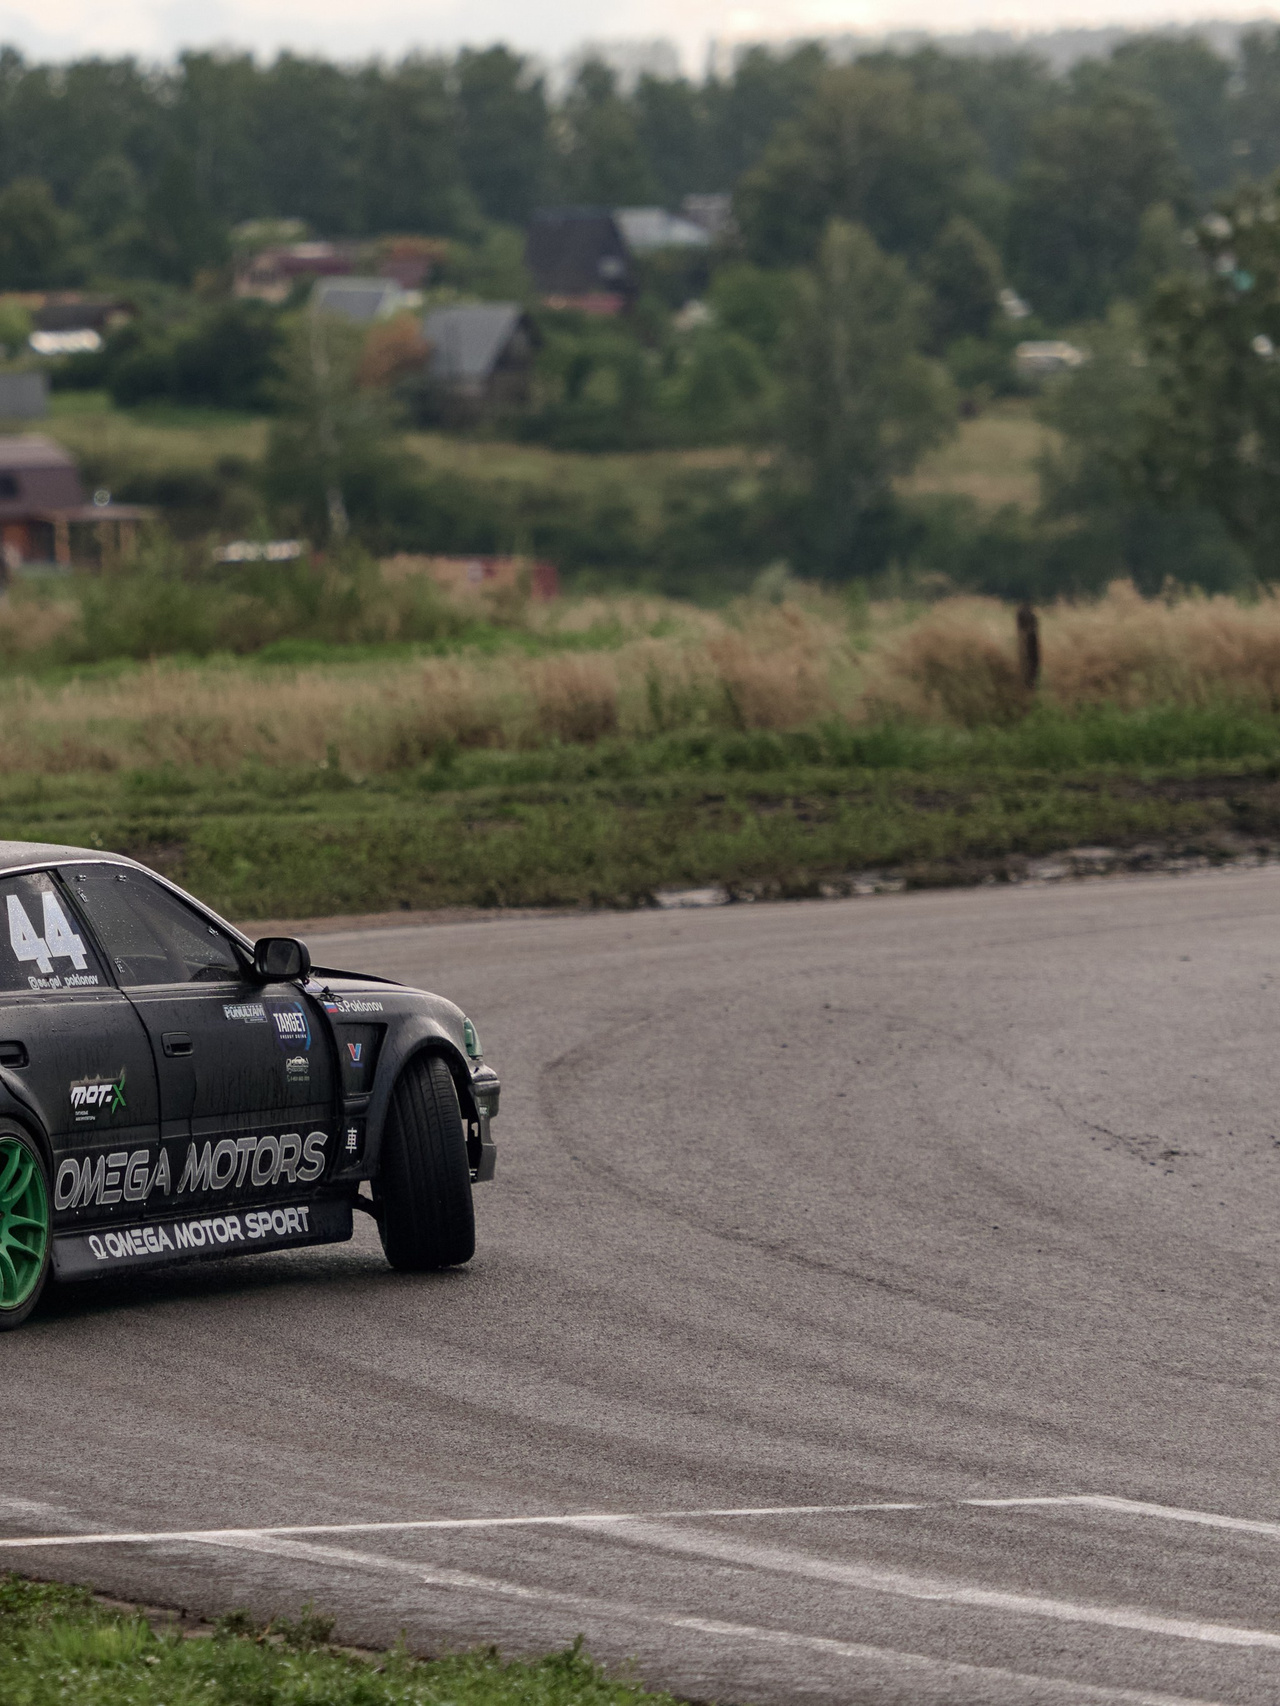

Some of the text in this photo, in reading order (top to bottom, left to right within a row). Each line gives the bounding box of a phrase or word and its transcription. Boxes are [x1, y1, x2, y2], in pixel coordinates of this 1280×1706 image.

[6, 891, 88, 974] 44
[273, 1012, 306, 1032] TARGET
[54, 1131, 328, 1210] OMEGA MOTORS
[104, 1226, 174, 1258] OMEGA
[173, 1216, 245, 1250] MOTOR
[245, 1206, 310, 1239] SPORT
